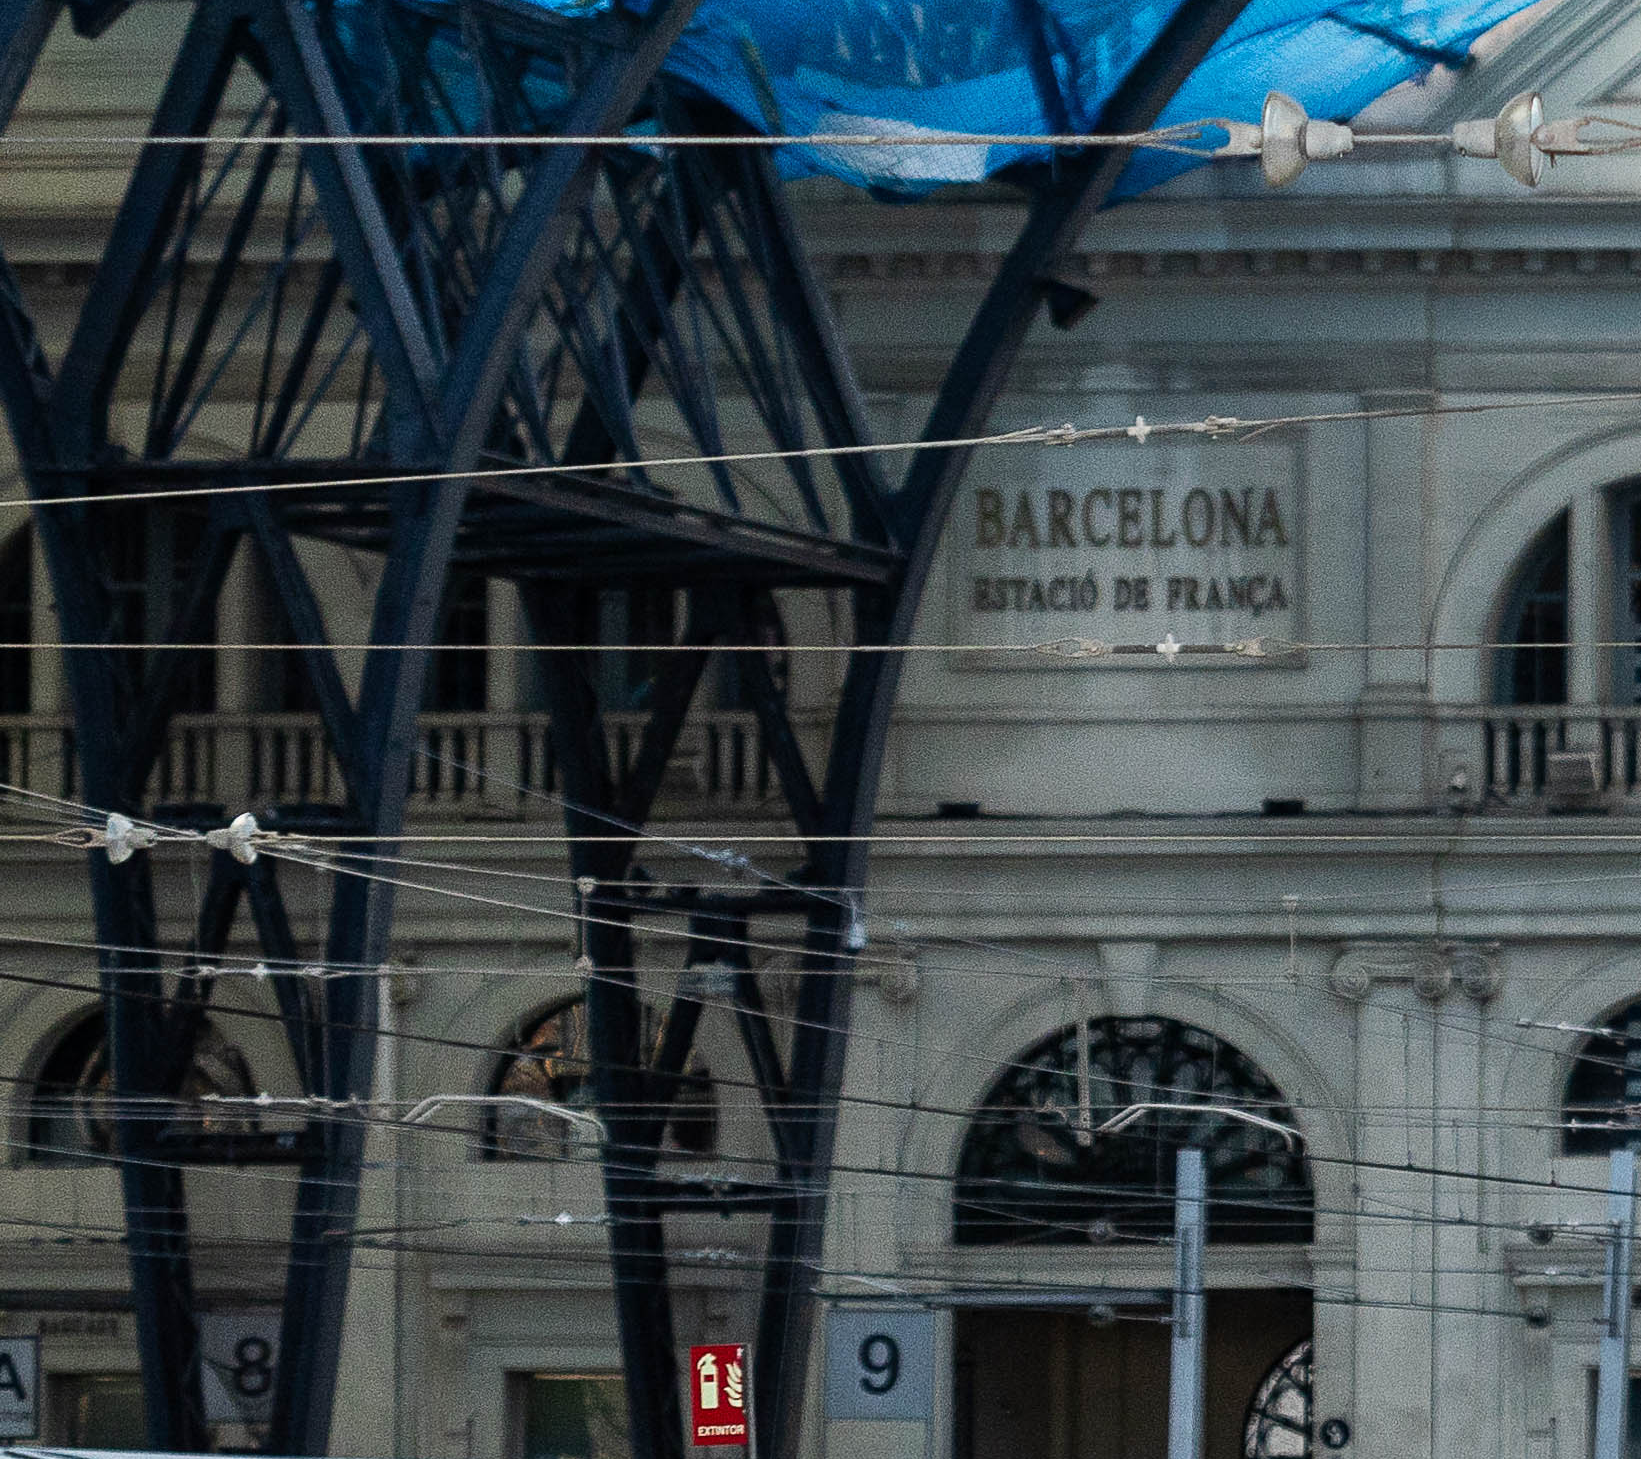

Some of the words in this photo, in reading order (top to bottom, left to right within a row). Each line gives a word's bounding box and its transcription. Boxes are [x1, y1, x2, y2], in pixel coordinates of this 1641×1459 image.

[975, 487, 1288, 547] BARCELONA
[974, 568, 1098, 611] ESTACIÓ
[1113, 577, 1149, 611] DE
[1167, 575, 1288, 617] FRANÇA
[235, 1338, 270, 1396] 8
[858, 1334, 900, 1395] 9
